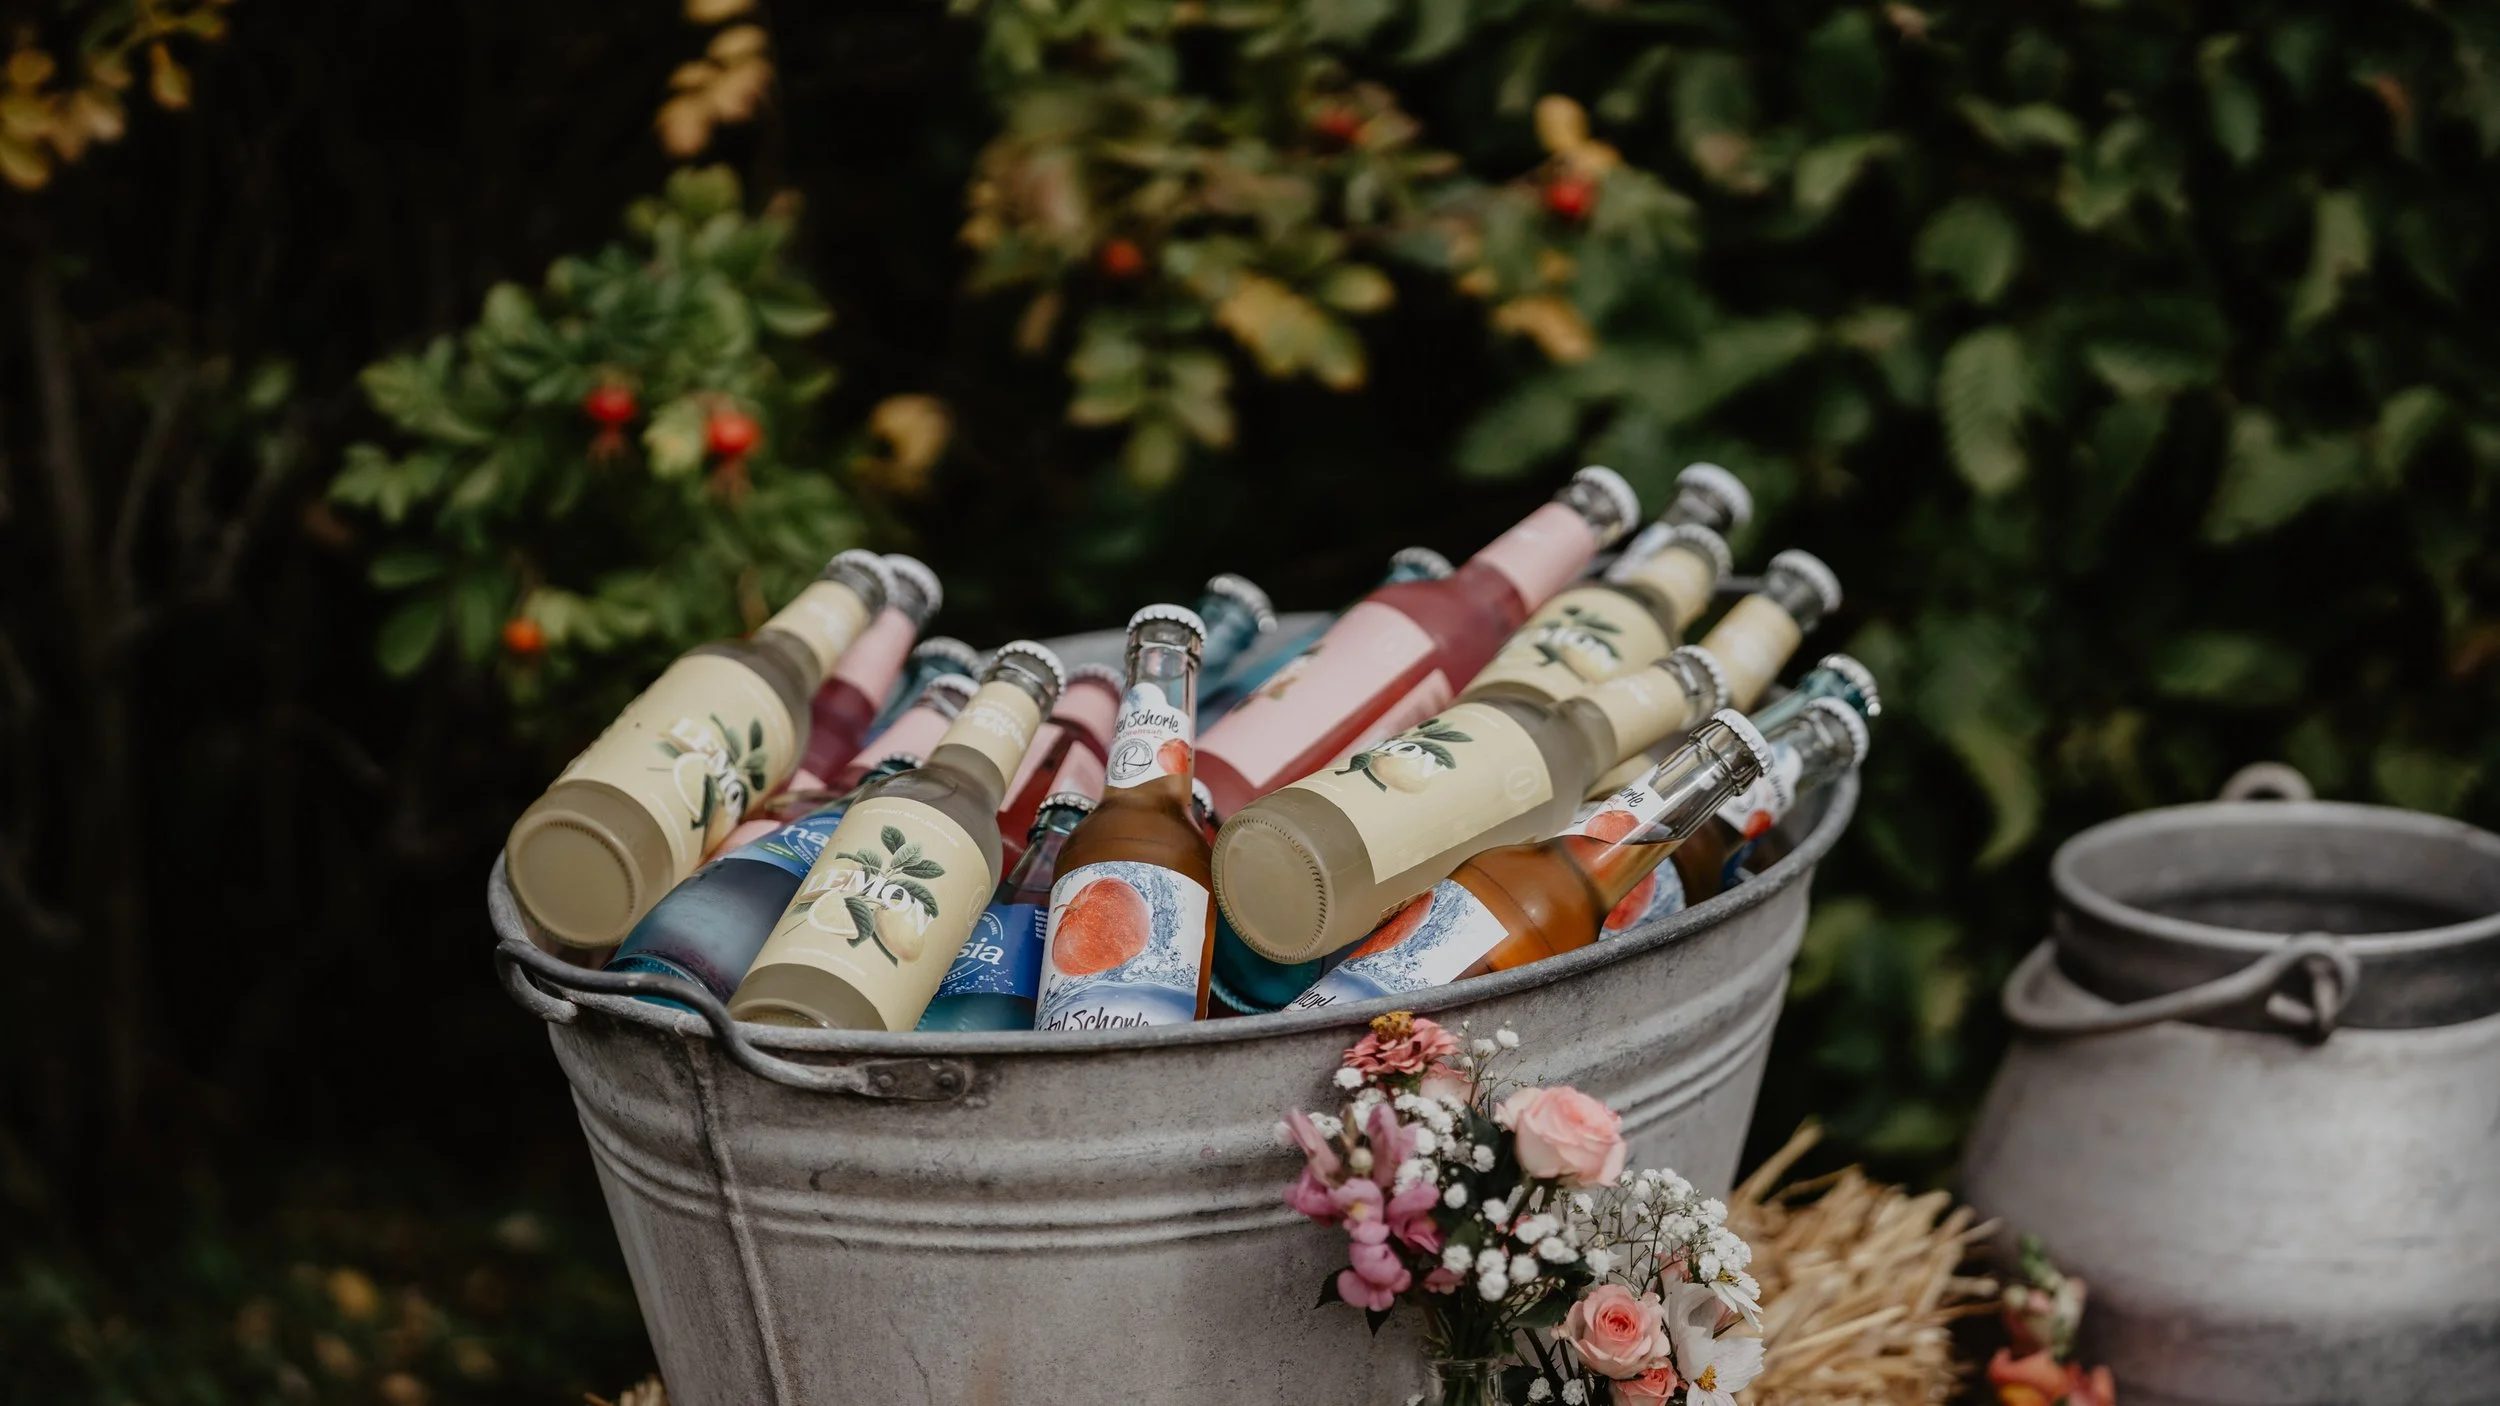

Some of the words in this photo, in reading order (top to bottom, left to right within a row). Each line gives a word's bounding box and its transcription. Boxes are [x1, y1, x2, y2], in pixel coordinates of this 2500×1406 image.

[1127, 709, 1179, 733] Schorle
[802, 868, 936, 938] LEMON
[957, 937, 1004, 966] sia
